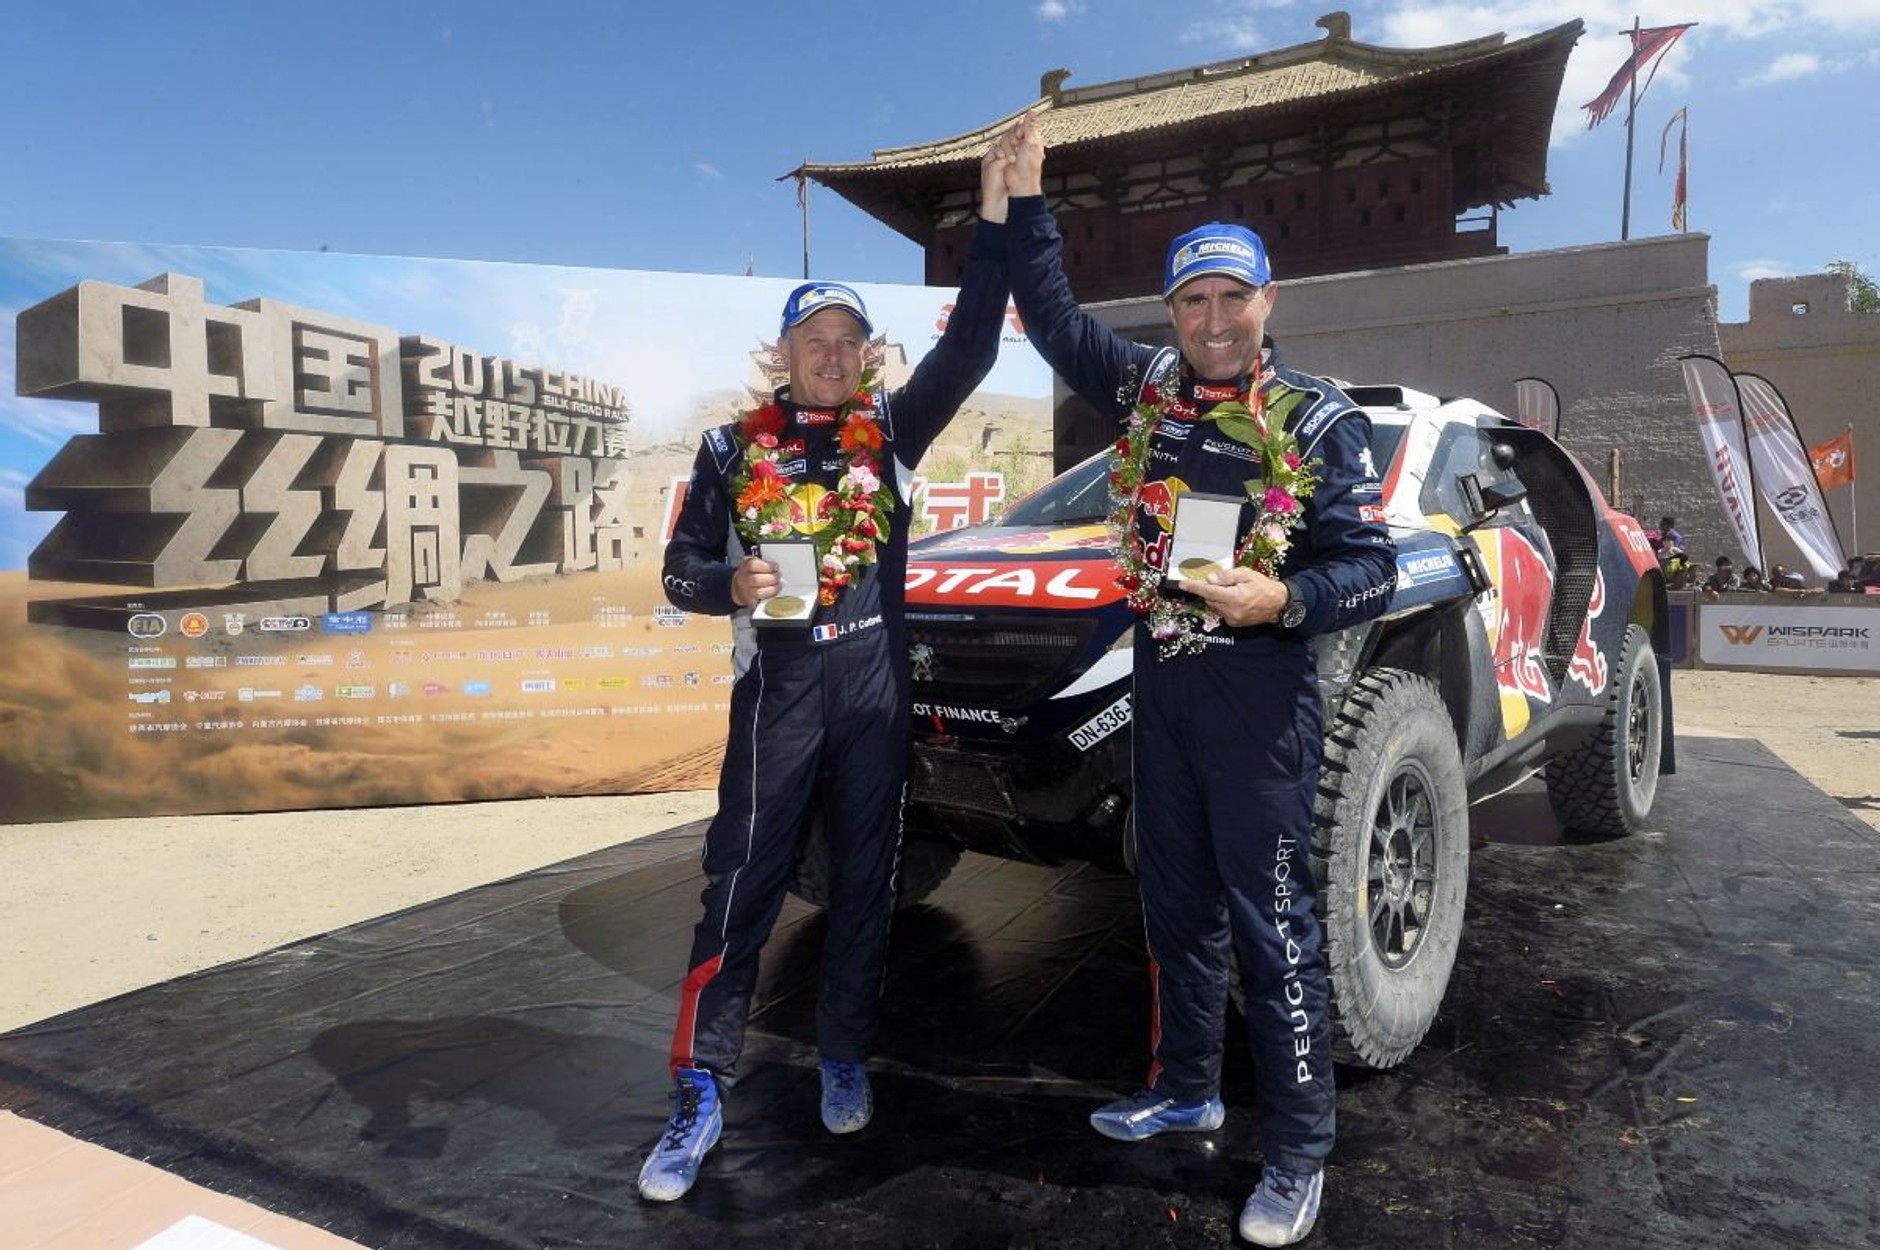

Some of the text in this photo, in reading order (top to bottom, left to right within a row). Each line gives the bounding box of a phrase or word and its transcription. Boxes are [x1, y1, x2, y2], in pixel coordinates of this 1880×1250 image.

[78, 272, 404, 438] 中国
[418, 335, 536, 405] 2015
[543, 394, 569, 410] SILK
[573, 401, 603, 417] ROAD
[427, 390, 630, 458] 越野拉力赛
[150, 426, 634, 610] 丝绸之路
[1406, 551, 1456, 575] MICHELIN
[905, 568, 1101, 600] OTAL
[838, 623, 848, 635] J.
[1768, 625, 1870, 639] WISPARK
[935, 705, 1001, 724] FINANCE
